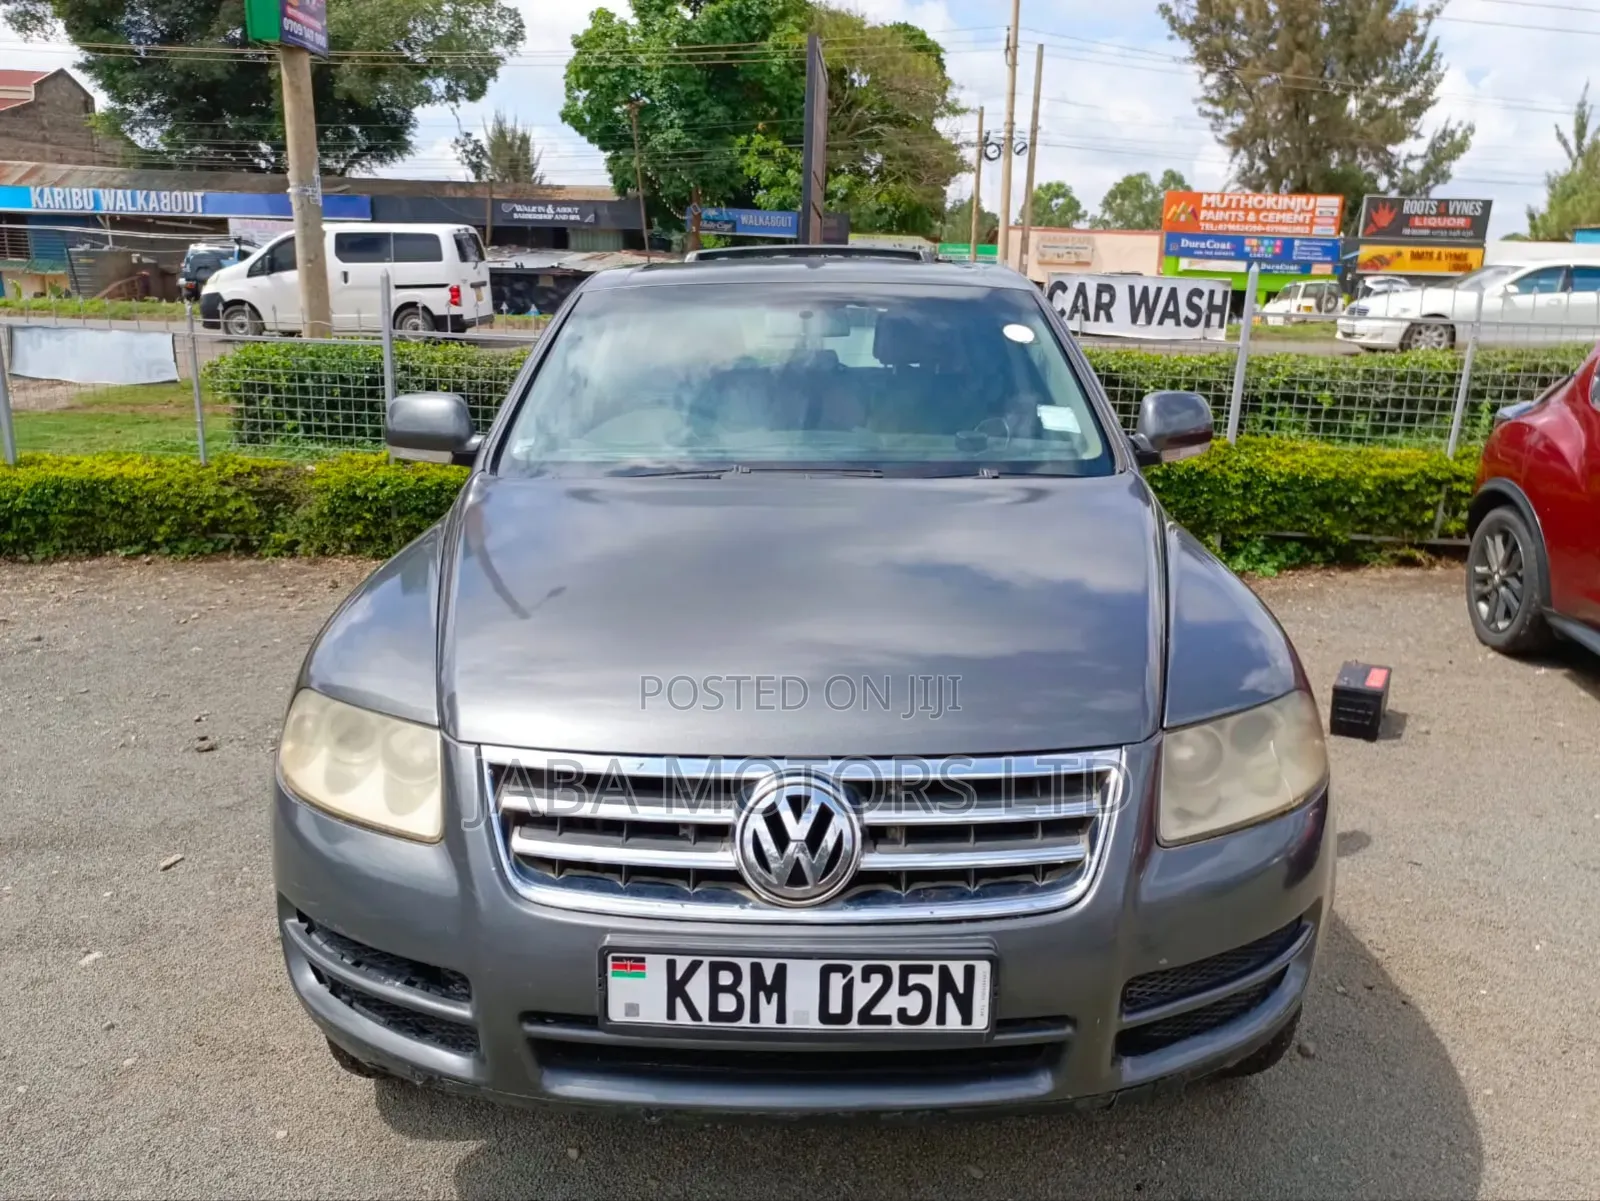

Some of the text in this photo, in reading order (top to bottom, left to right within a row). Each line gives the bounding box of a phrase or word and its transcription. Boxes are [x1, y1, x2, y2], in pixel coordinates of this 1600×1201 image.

[30, 186, 204, 213] KARIBU WALKABOUT
[1201, 194, 1315, 212] MUTHOKINJU
[546, 204, 554, 214] &
[1403, 199, 1438, 215] ROOTS
[1448, 200, 1484, 216] VYNES
[740, 214, 793, 228] WALKABOUT
[1200, 210, 1313, 224] PAINTS & CEMENT
[1414, 217, 1466, 227] LIQUOR
[1180, 238, 1231, 249] DuraCoat
[1047, 280, 1230, 329] CAR WASH
[665, 957, 788, 1025] KBM
[818, 962, 976, 1027] 025N
